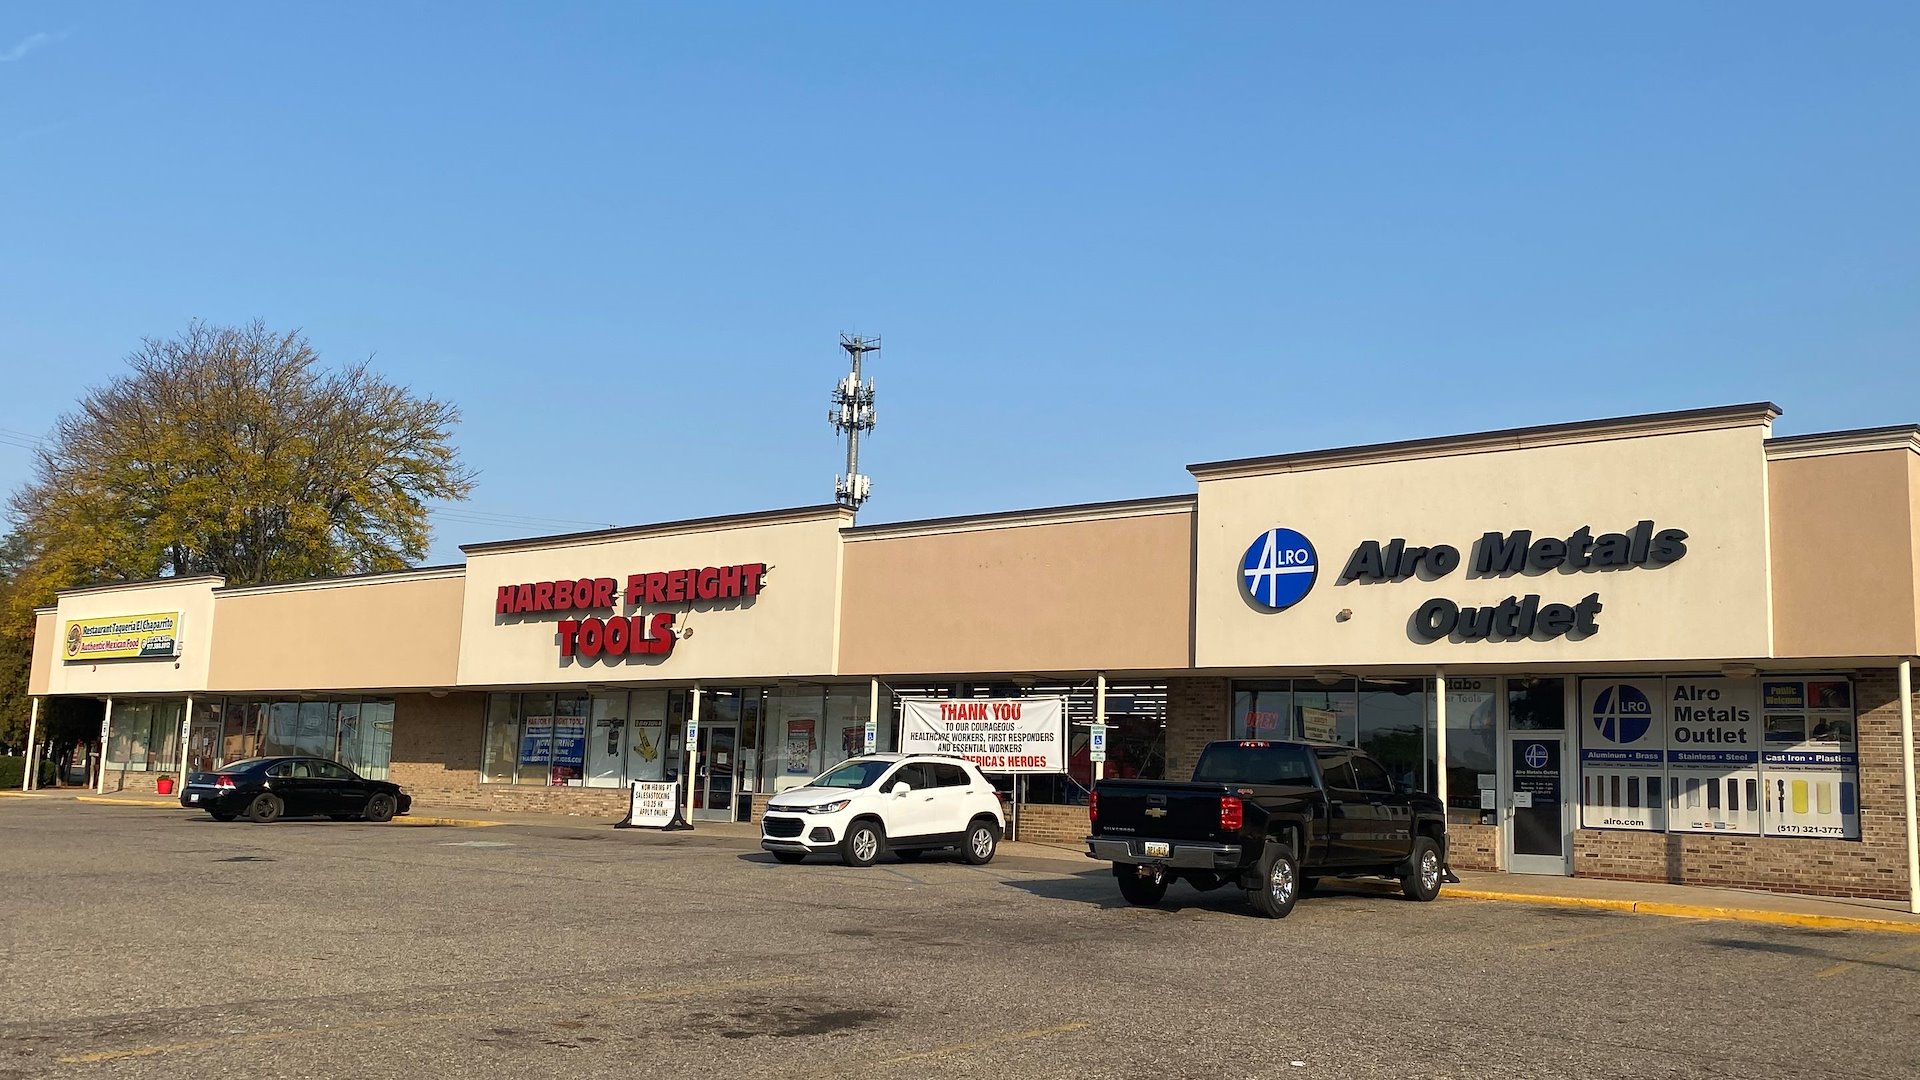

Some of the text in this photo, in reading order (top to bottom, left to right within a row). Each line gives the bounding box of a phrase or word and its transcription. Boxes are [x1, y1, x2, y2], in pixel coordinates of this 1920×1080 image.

[1343, 520, 1688, 579] Alro Metals
[497, 563, 767, 614] HARBOR FREIGHT
[1415, 593, 1602, 638] Outlet
[83, 624, 112, 636] Restaurant
[136, 620, 142, 631] El
[142, 617, 174, 633] Chaparrito
[558, 612, 677, 657] TOOLS
[81, 641, 105, 651] Authentic
[106, 639, 127, 650] Mexican
[127, 637, 139, 648] Food
[1673, 684, 1721, 701] Alro
[1770, 686, 1797, 695] Public
[1765, 695, 1802, 705] Welcome
[940, 703, 1022, 721] THANK YOU
[1674, 706, 1750, 722] Metals
[1245, 711, 1278, 729] OPEN
[945, 722, 1015, 732] TO OUR COURAGEOUS
[910, 732, 1054, 743] HEALTHCARE WORKERS, FIRST RESPONDERS
[1674, 727, 1748, 744] Outlet
[937, 743, 1022, 753] AND ESSENTIAL WORKERS
[1008, 755, 1047, 767] HEROES
[1587, 752, 1659, 760] Aluminum Brass
[1677, 753, 1748, 761] Stainless Steel
[1765, 754, 1852, 763] Cast Iron Plastics
[640, 808, 668, 817] APPLY ONLINE
[1603, 818, 1644, 826] alro.com
[1777, 825, 1844, 834] (517) 321-3773
